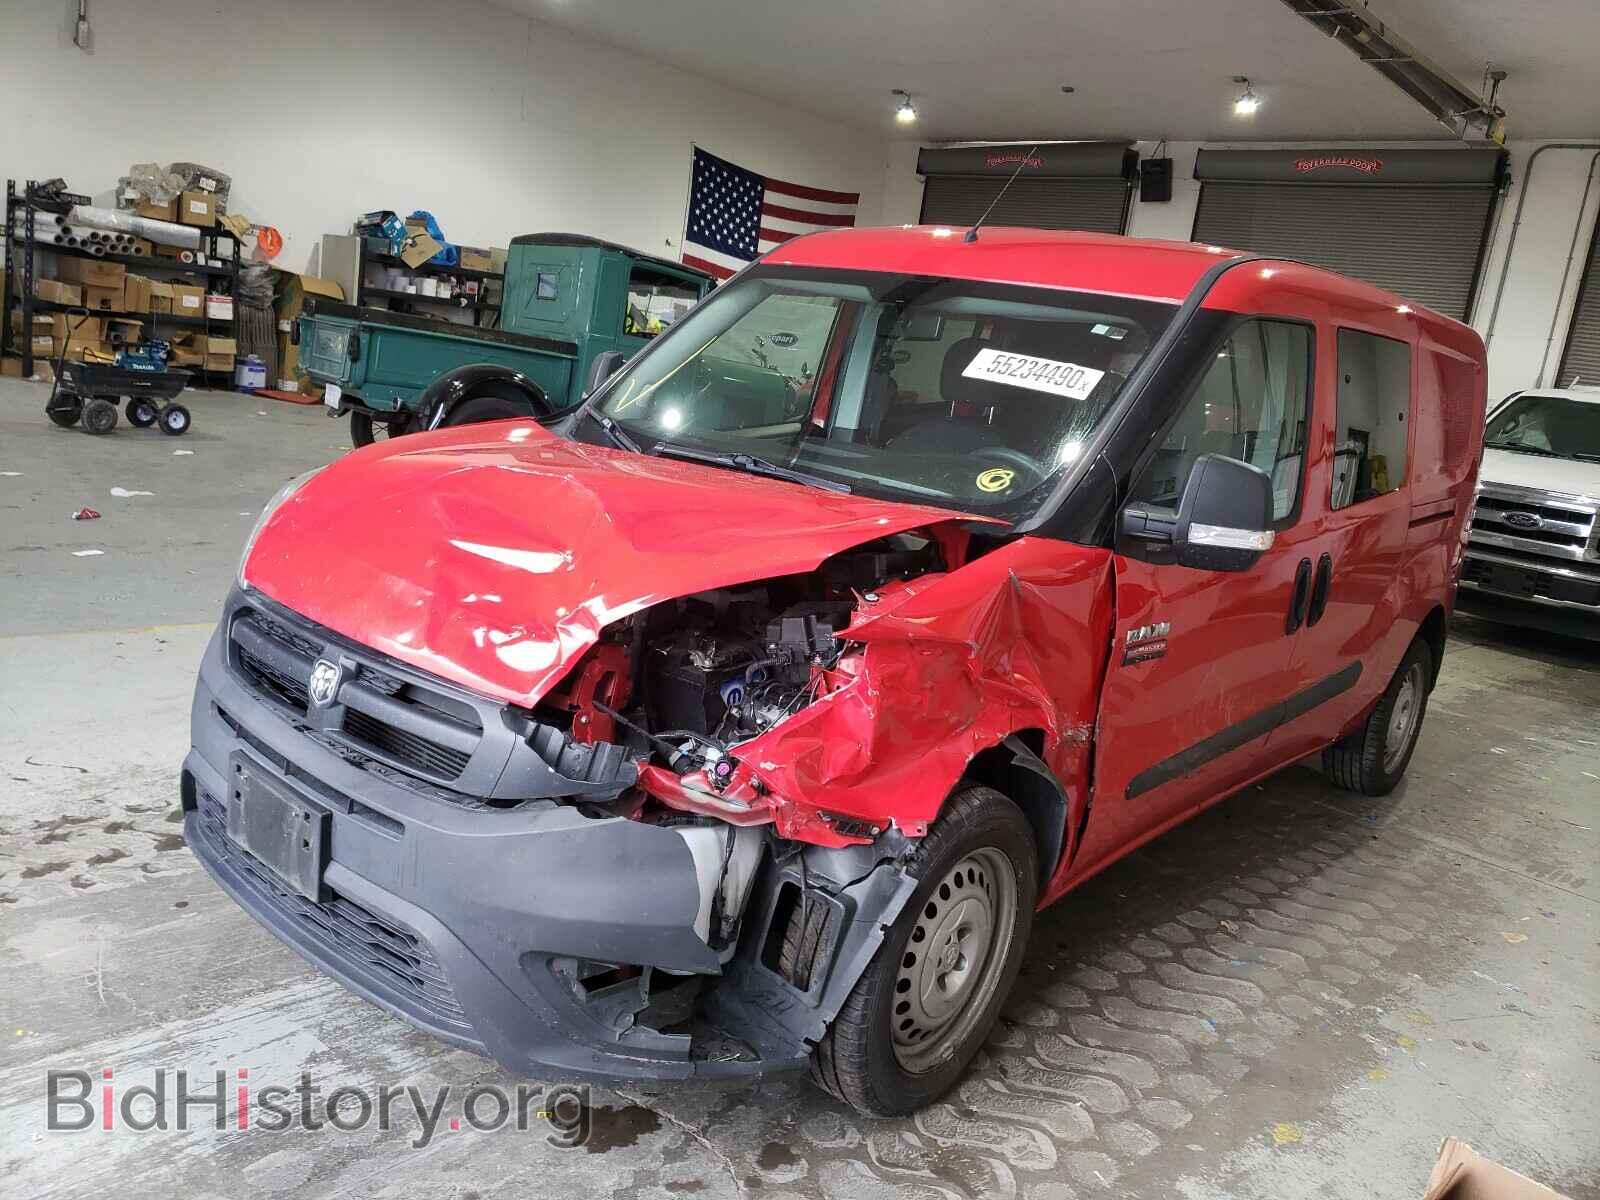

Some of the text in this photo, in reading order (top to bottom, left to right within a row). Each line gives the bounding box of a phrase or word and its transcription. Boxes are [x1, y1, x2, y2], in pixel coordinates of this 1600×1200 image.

[1302, 158, 1373, 171] OVERHEAD DOOR
[987, 354, 1086, 389] 55234490
